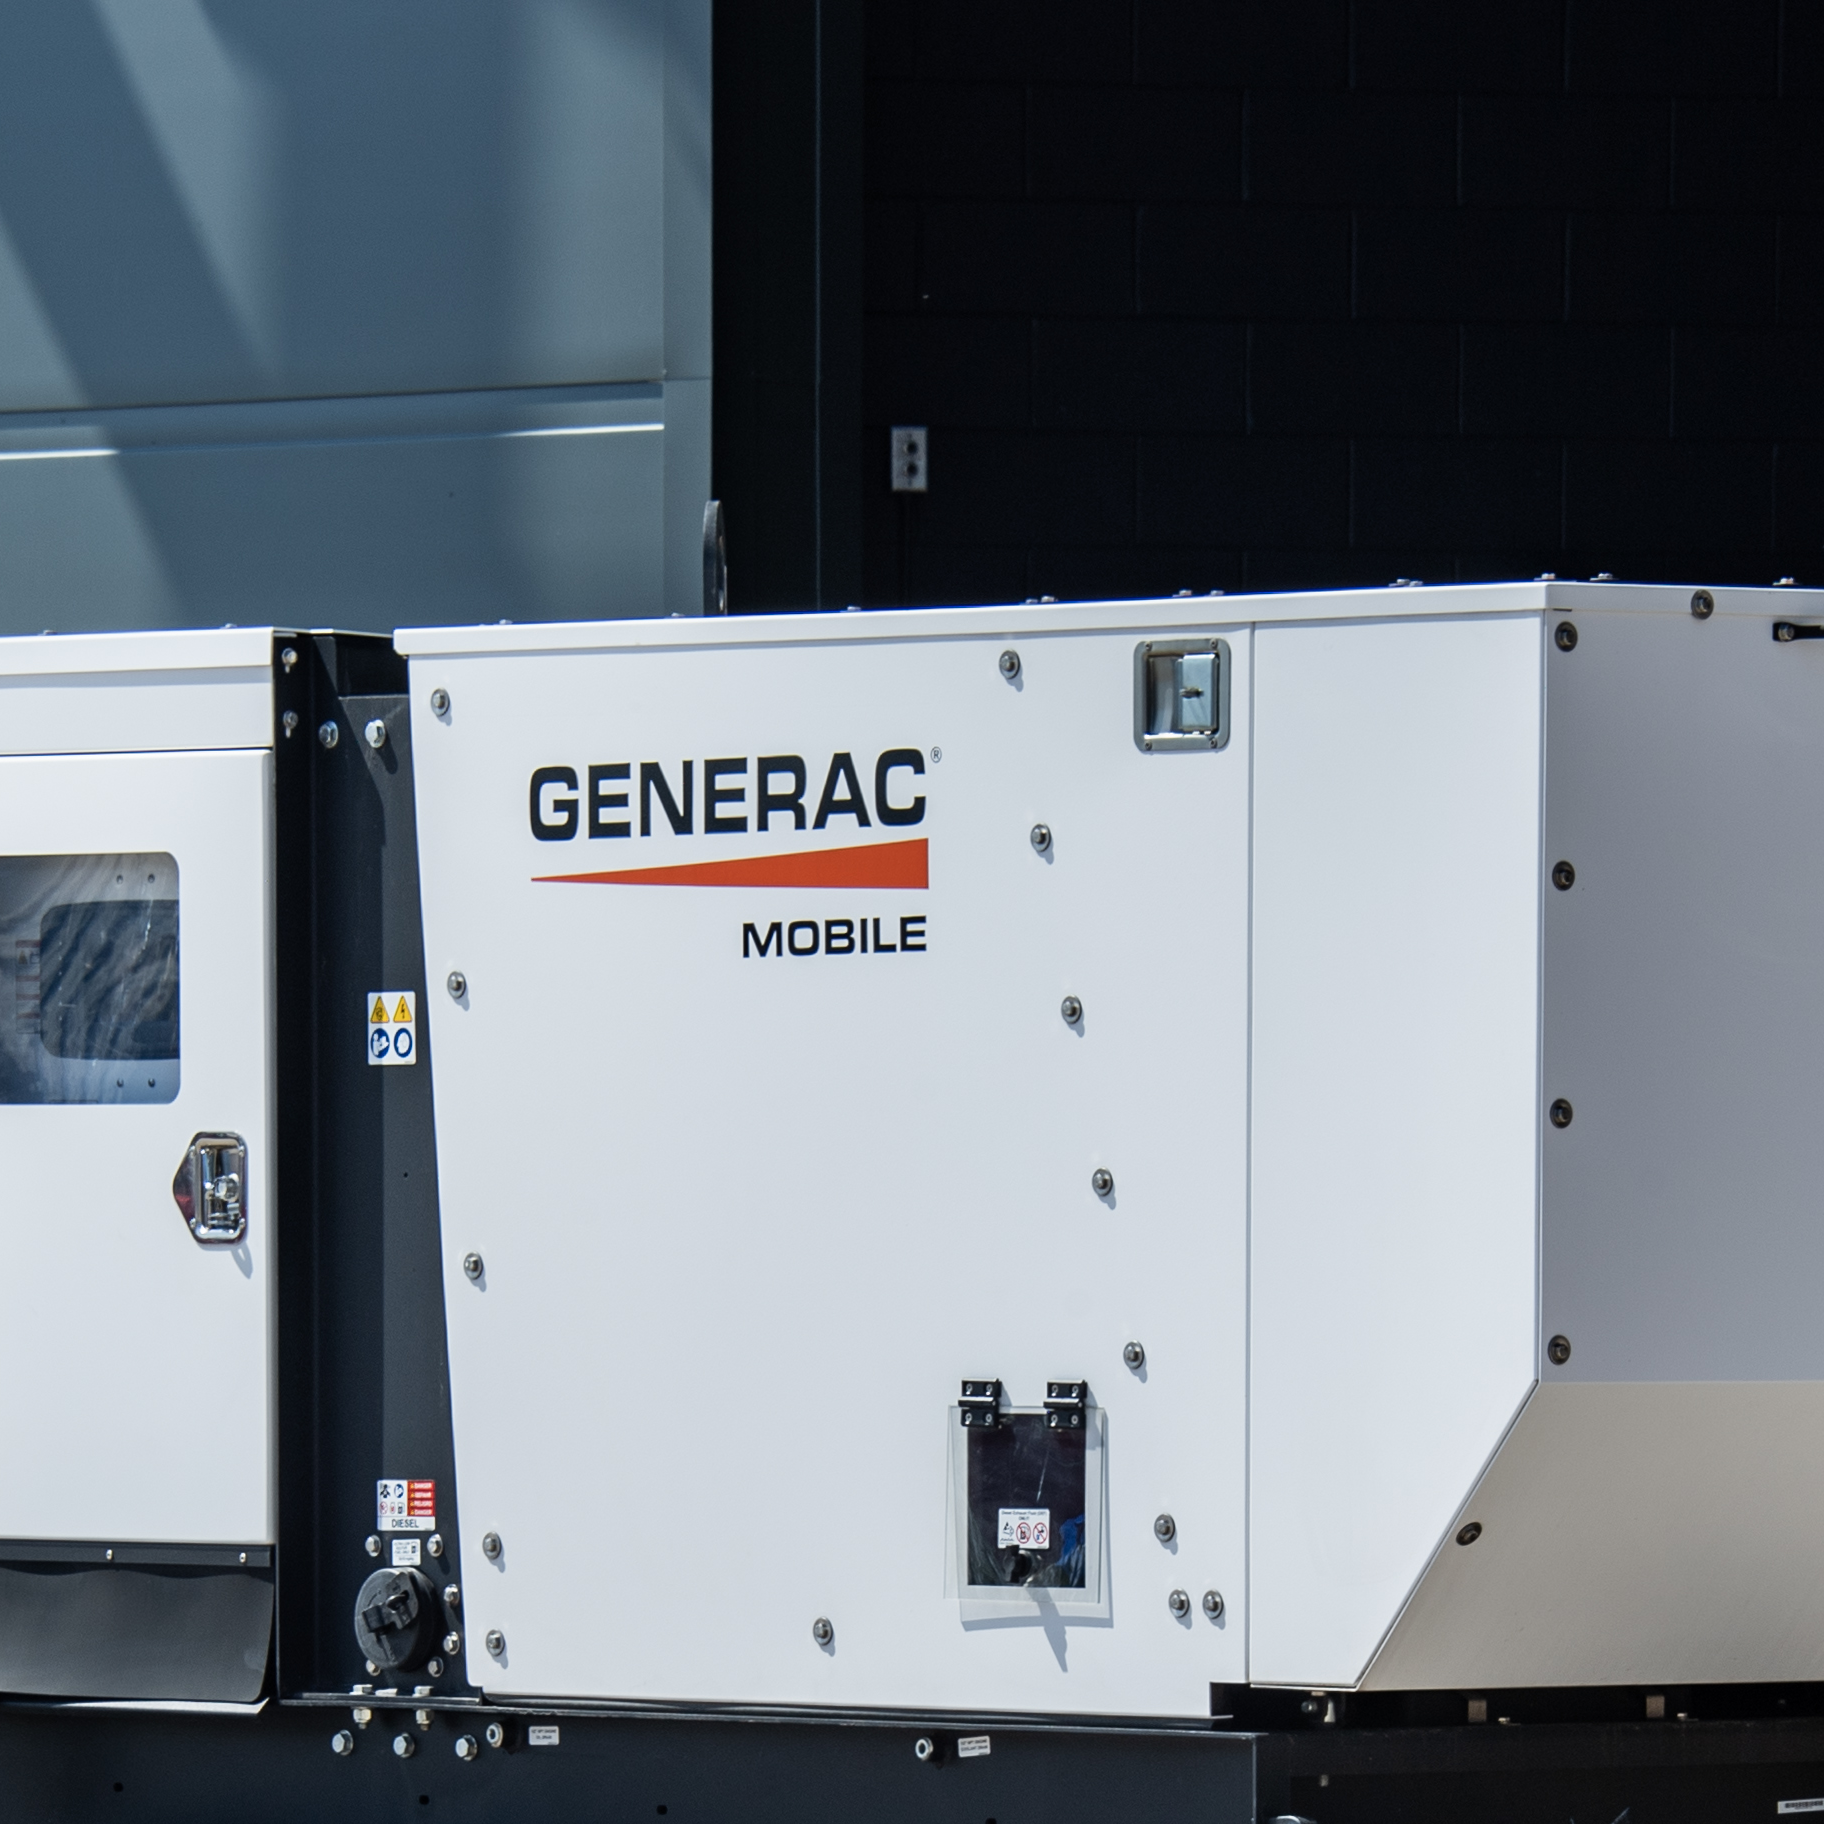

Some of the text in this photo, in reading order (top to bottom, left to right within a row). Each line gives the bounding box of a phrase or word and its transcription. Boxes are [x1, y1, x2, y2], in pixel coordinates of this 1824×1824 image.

[529, 747, 927, 842] GENERAC
[741, 915, 927, 959] MOBILE
[391, 1518, 420, 1529] DIESEL
